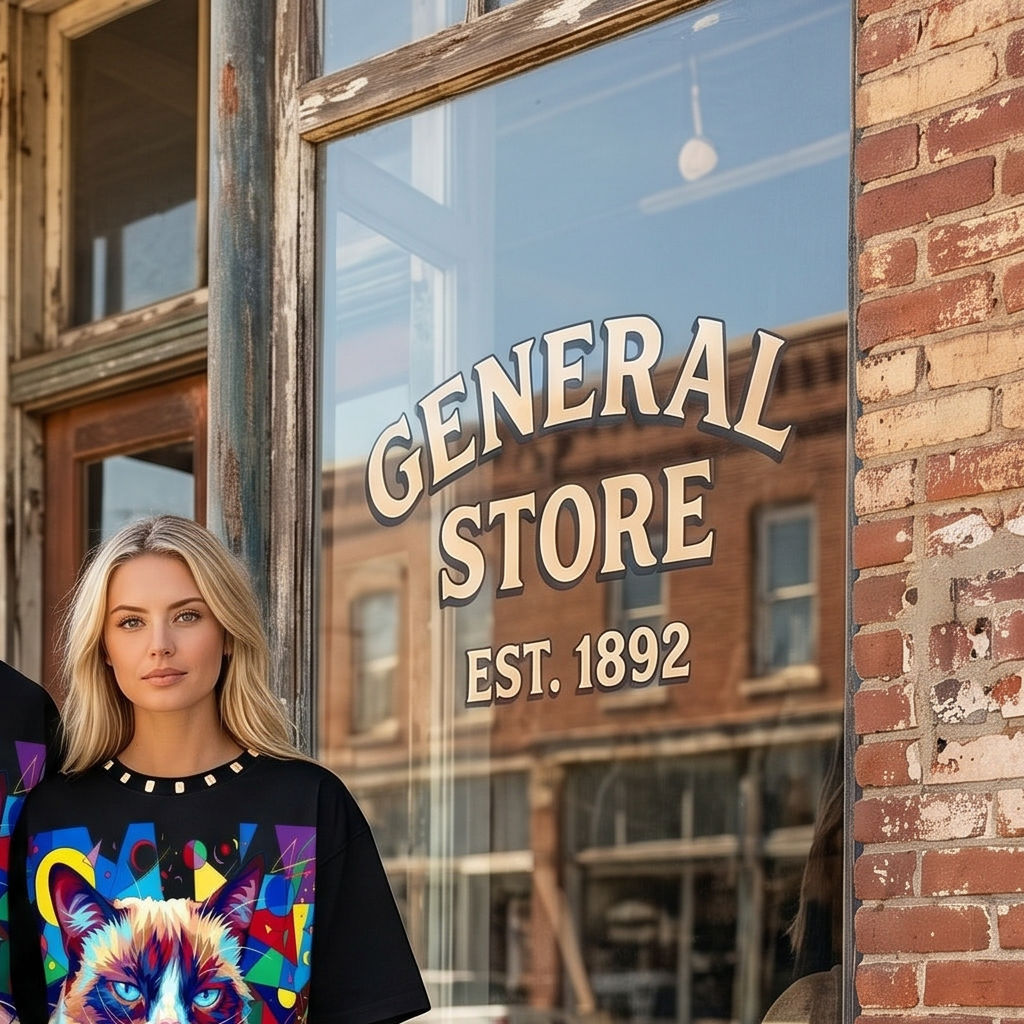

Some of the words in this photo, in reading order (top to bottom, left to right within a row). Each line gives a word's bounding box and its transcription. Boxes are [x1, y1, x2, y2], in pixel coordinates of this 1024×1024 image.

[366, 315, 796, 526] GENERAL
[439, 459, 714, 608] STORE
[466, 639, 562, 707] EST.
[575, 622, 691, 689] 1892
